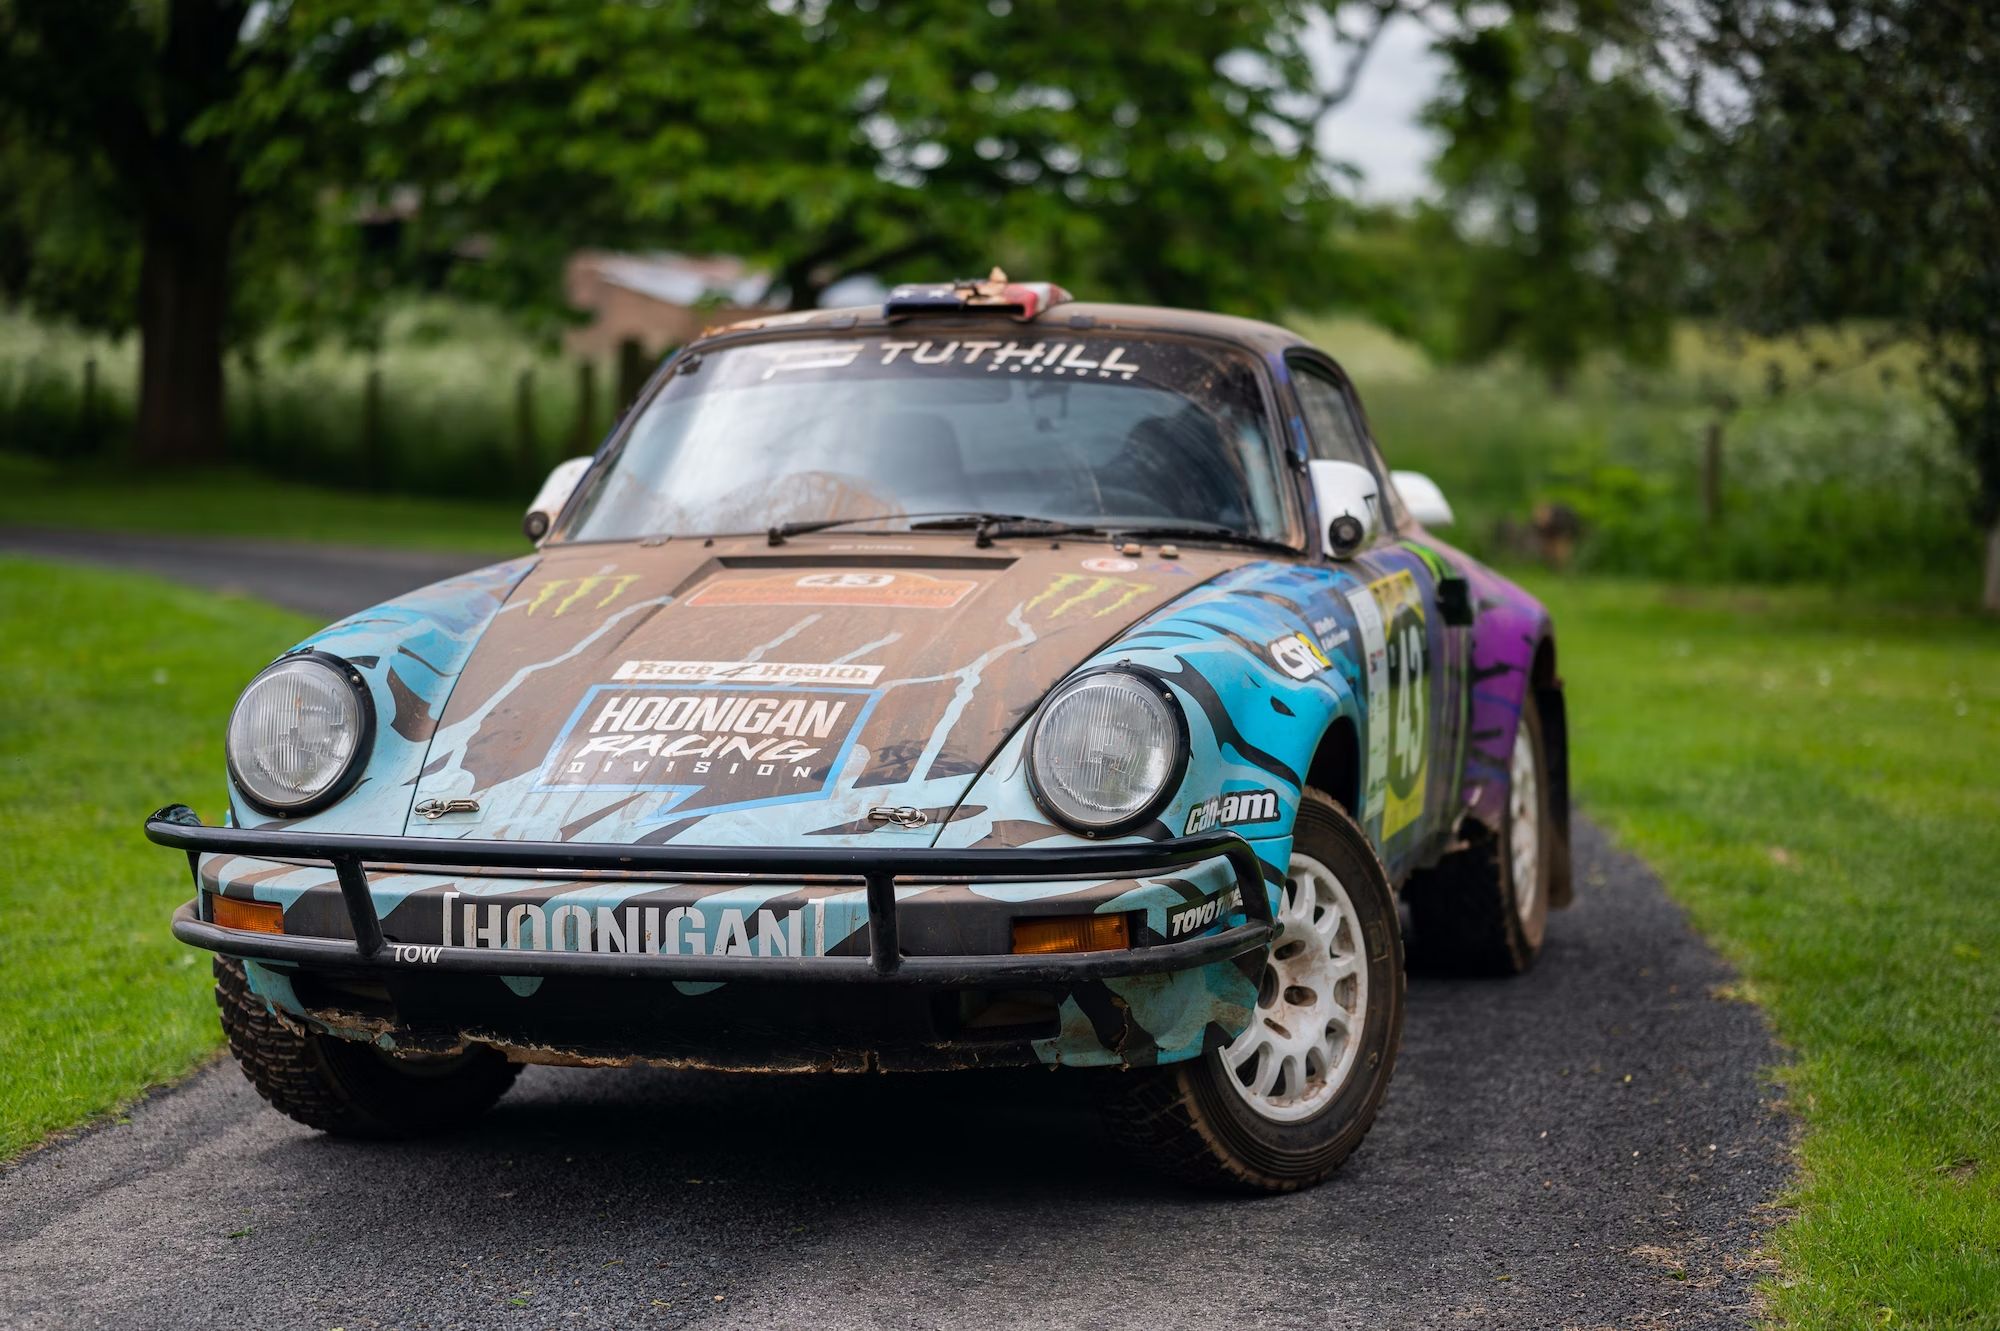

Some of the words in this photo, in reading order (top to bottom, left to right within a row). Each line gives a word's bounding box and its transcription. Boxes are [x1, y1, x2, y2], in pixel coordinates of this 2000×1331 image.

[880, 341, 1139, 373] TUTHILL
[714, 664, 757, 678] 4
[589, 695, 847, 738] HOONIGAN
[574, 733, 821, 763] RACING
[568, 760, 812, 778] DIVISION
[1171, 900, 1216, 937] TOYO
[392, 944, 444, 964] TOW
